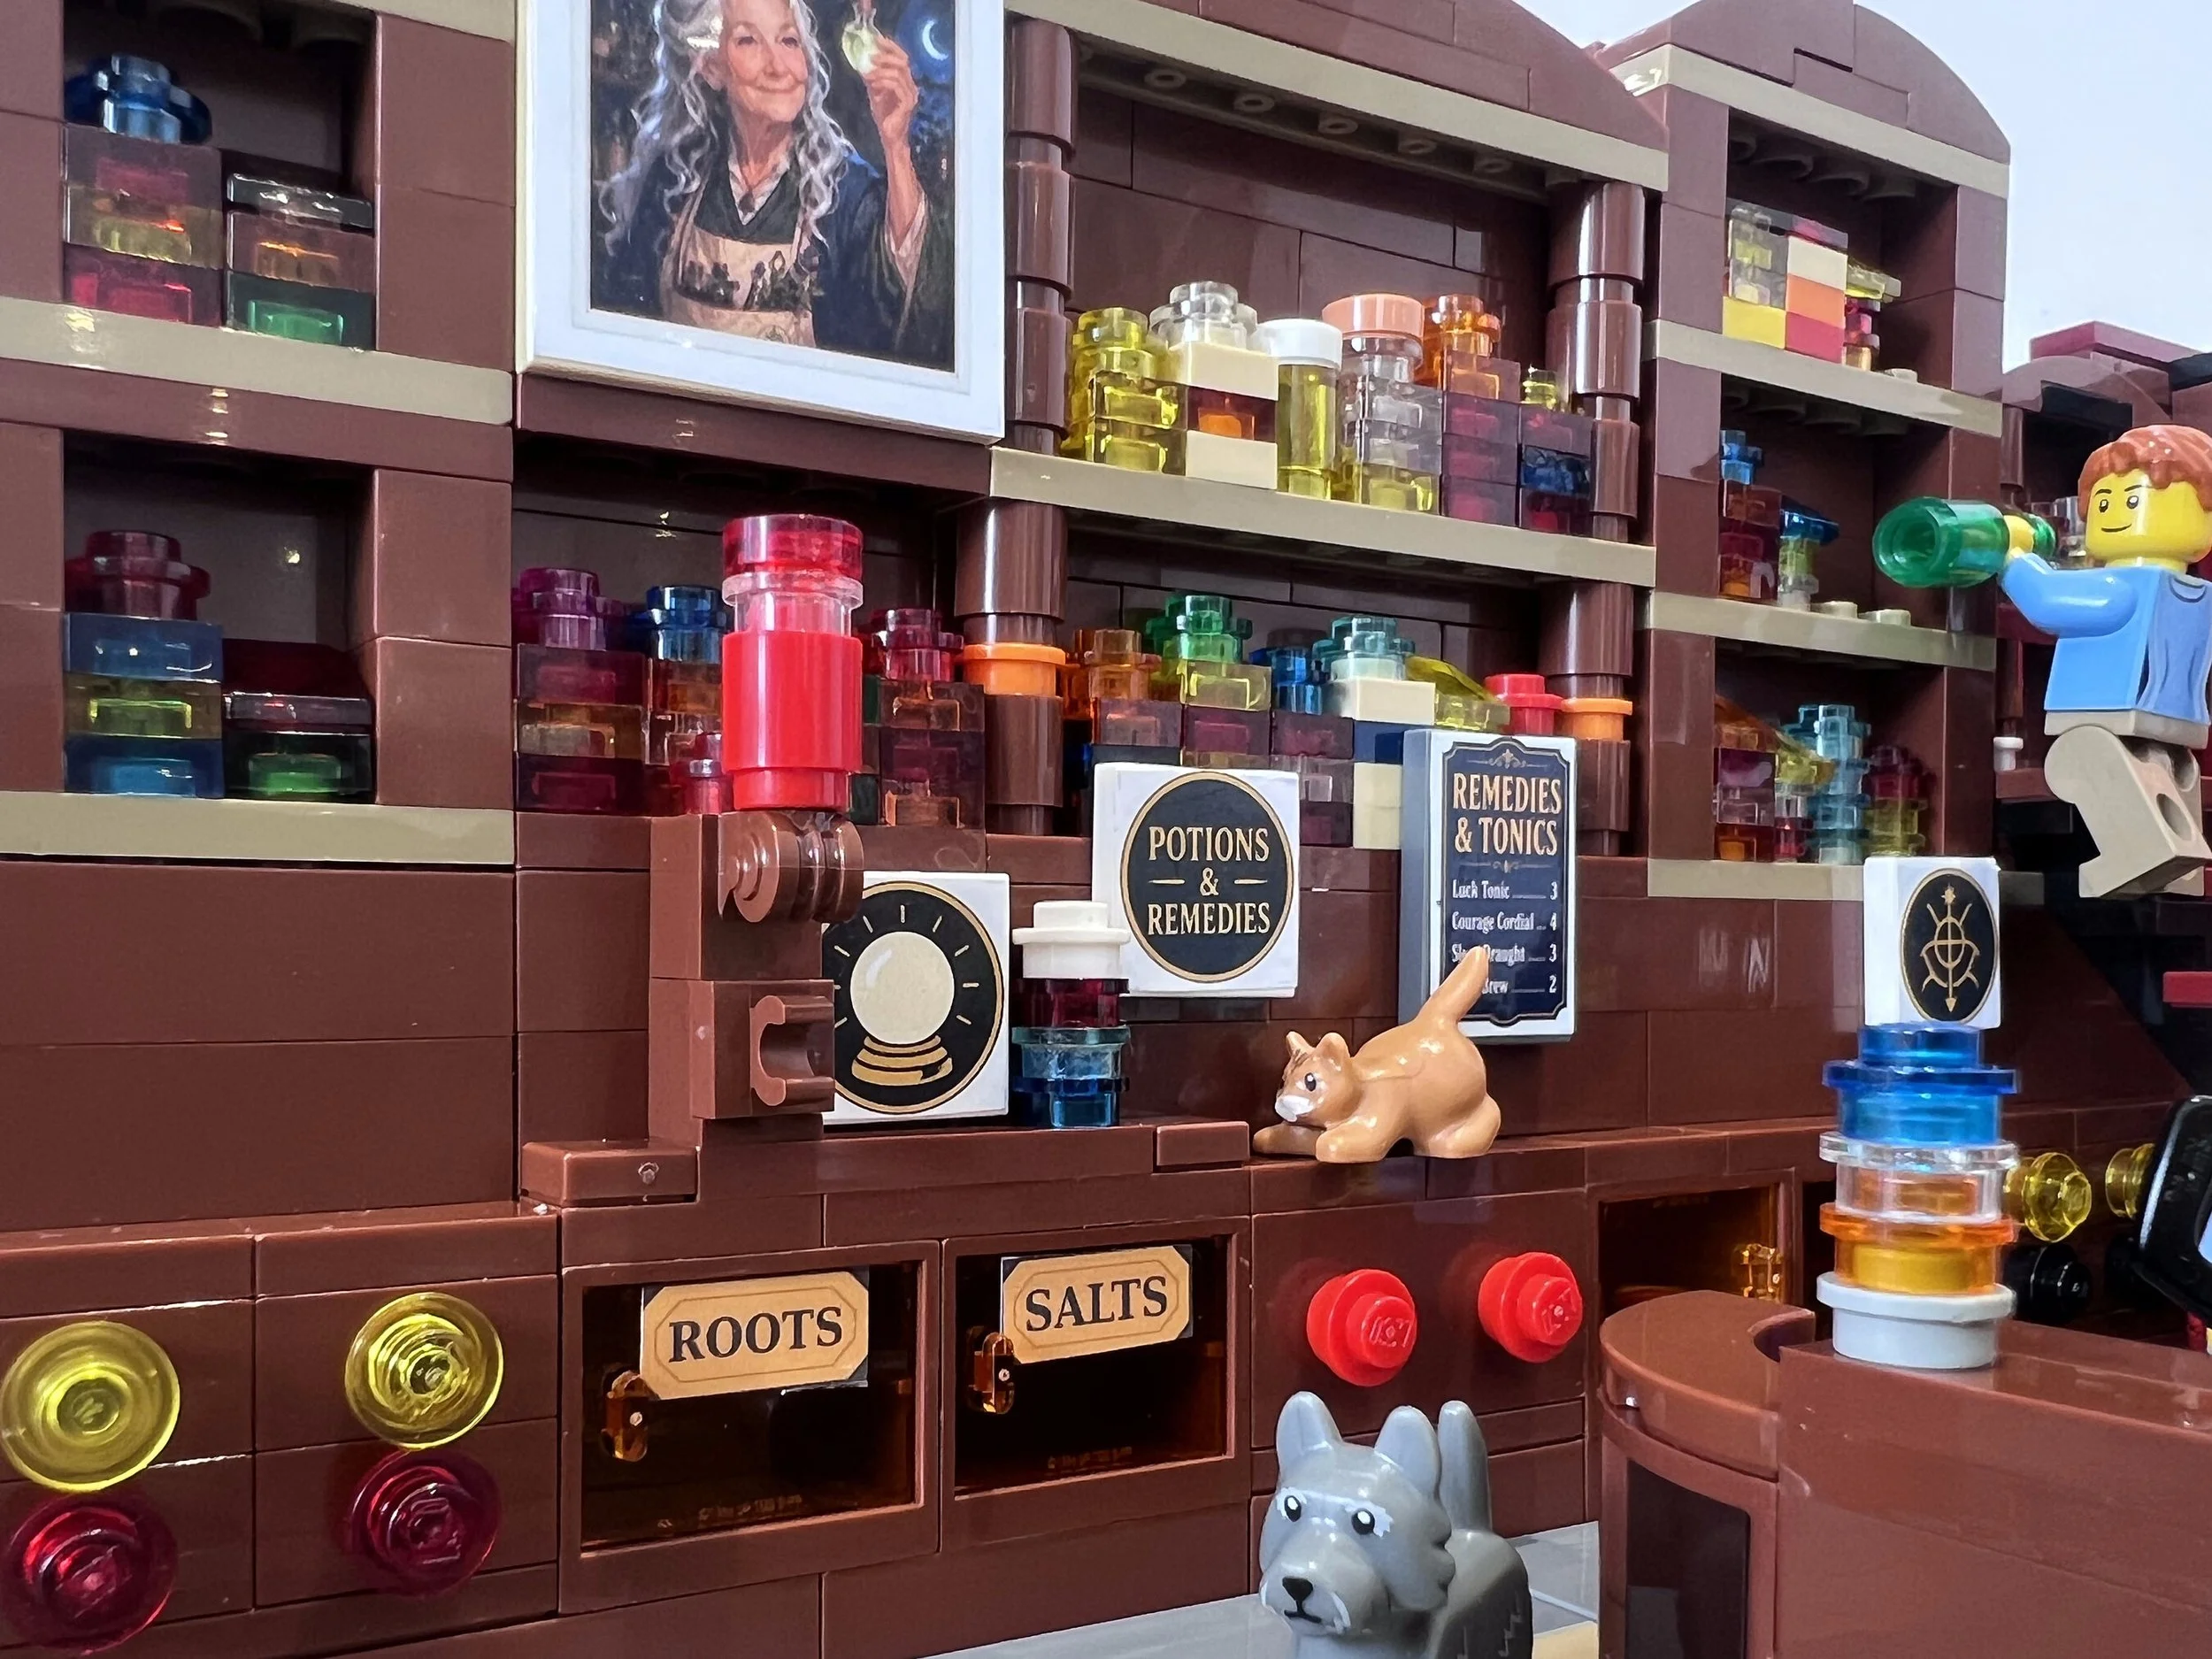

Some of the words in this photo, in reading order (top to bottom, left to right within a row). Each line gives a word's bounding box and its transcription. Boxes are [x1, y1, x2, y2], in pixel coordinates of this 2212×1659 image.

[1453, 772, 1562, 814] REMEDIES
[1148, 826, 1270, 862] POTIONS
[1455, 818, 1472, 853] &
[1479, 818, 1558, 856] TONICS
[1200, 868, 1219, 896] &
[1481, 880, 1510, 899] Tonic
[1549, 881, 1557, 901] 3
[1148, 902, 1271, 935] REMEDIES
[1452, 911, 1494, 934] Courage
[1549, 912, 1557, 931] 4
[1548, 943, 1557, 963] 3
[1548, 974, 1557, 994] 2
[1025, 1276, 1168, 1332] SALTS
[669, 1306, 842, 1363] ROOTS
